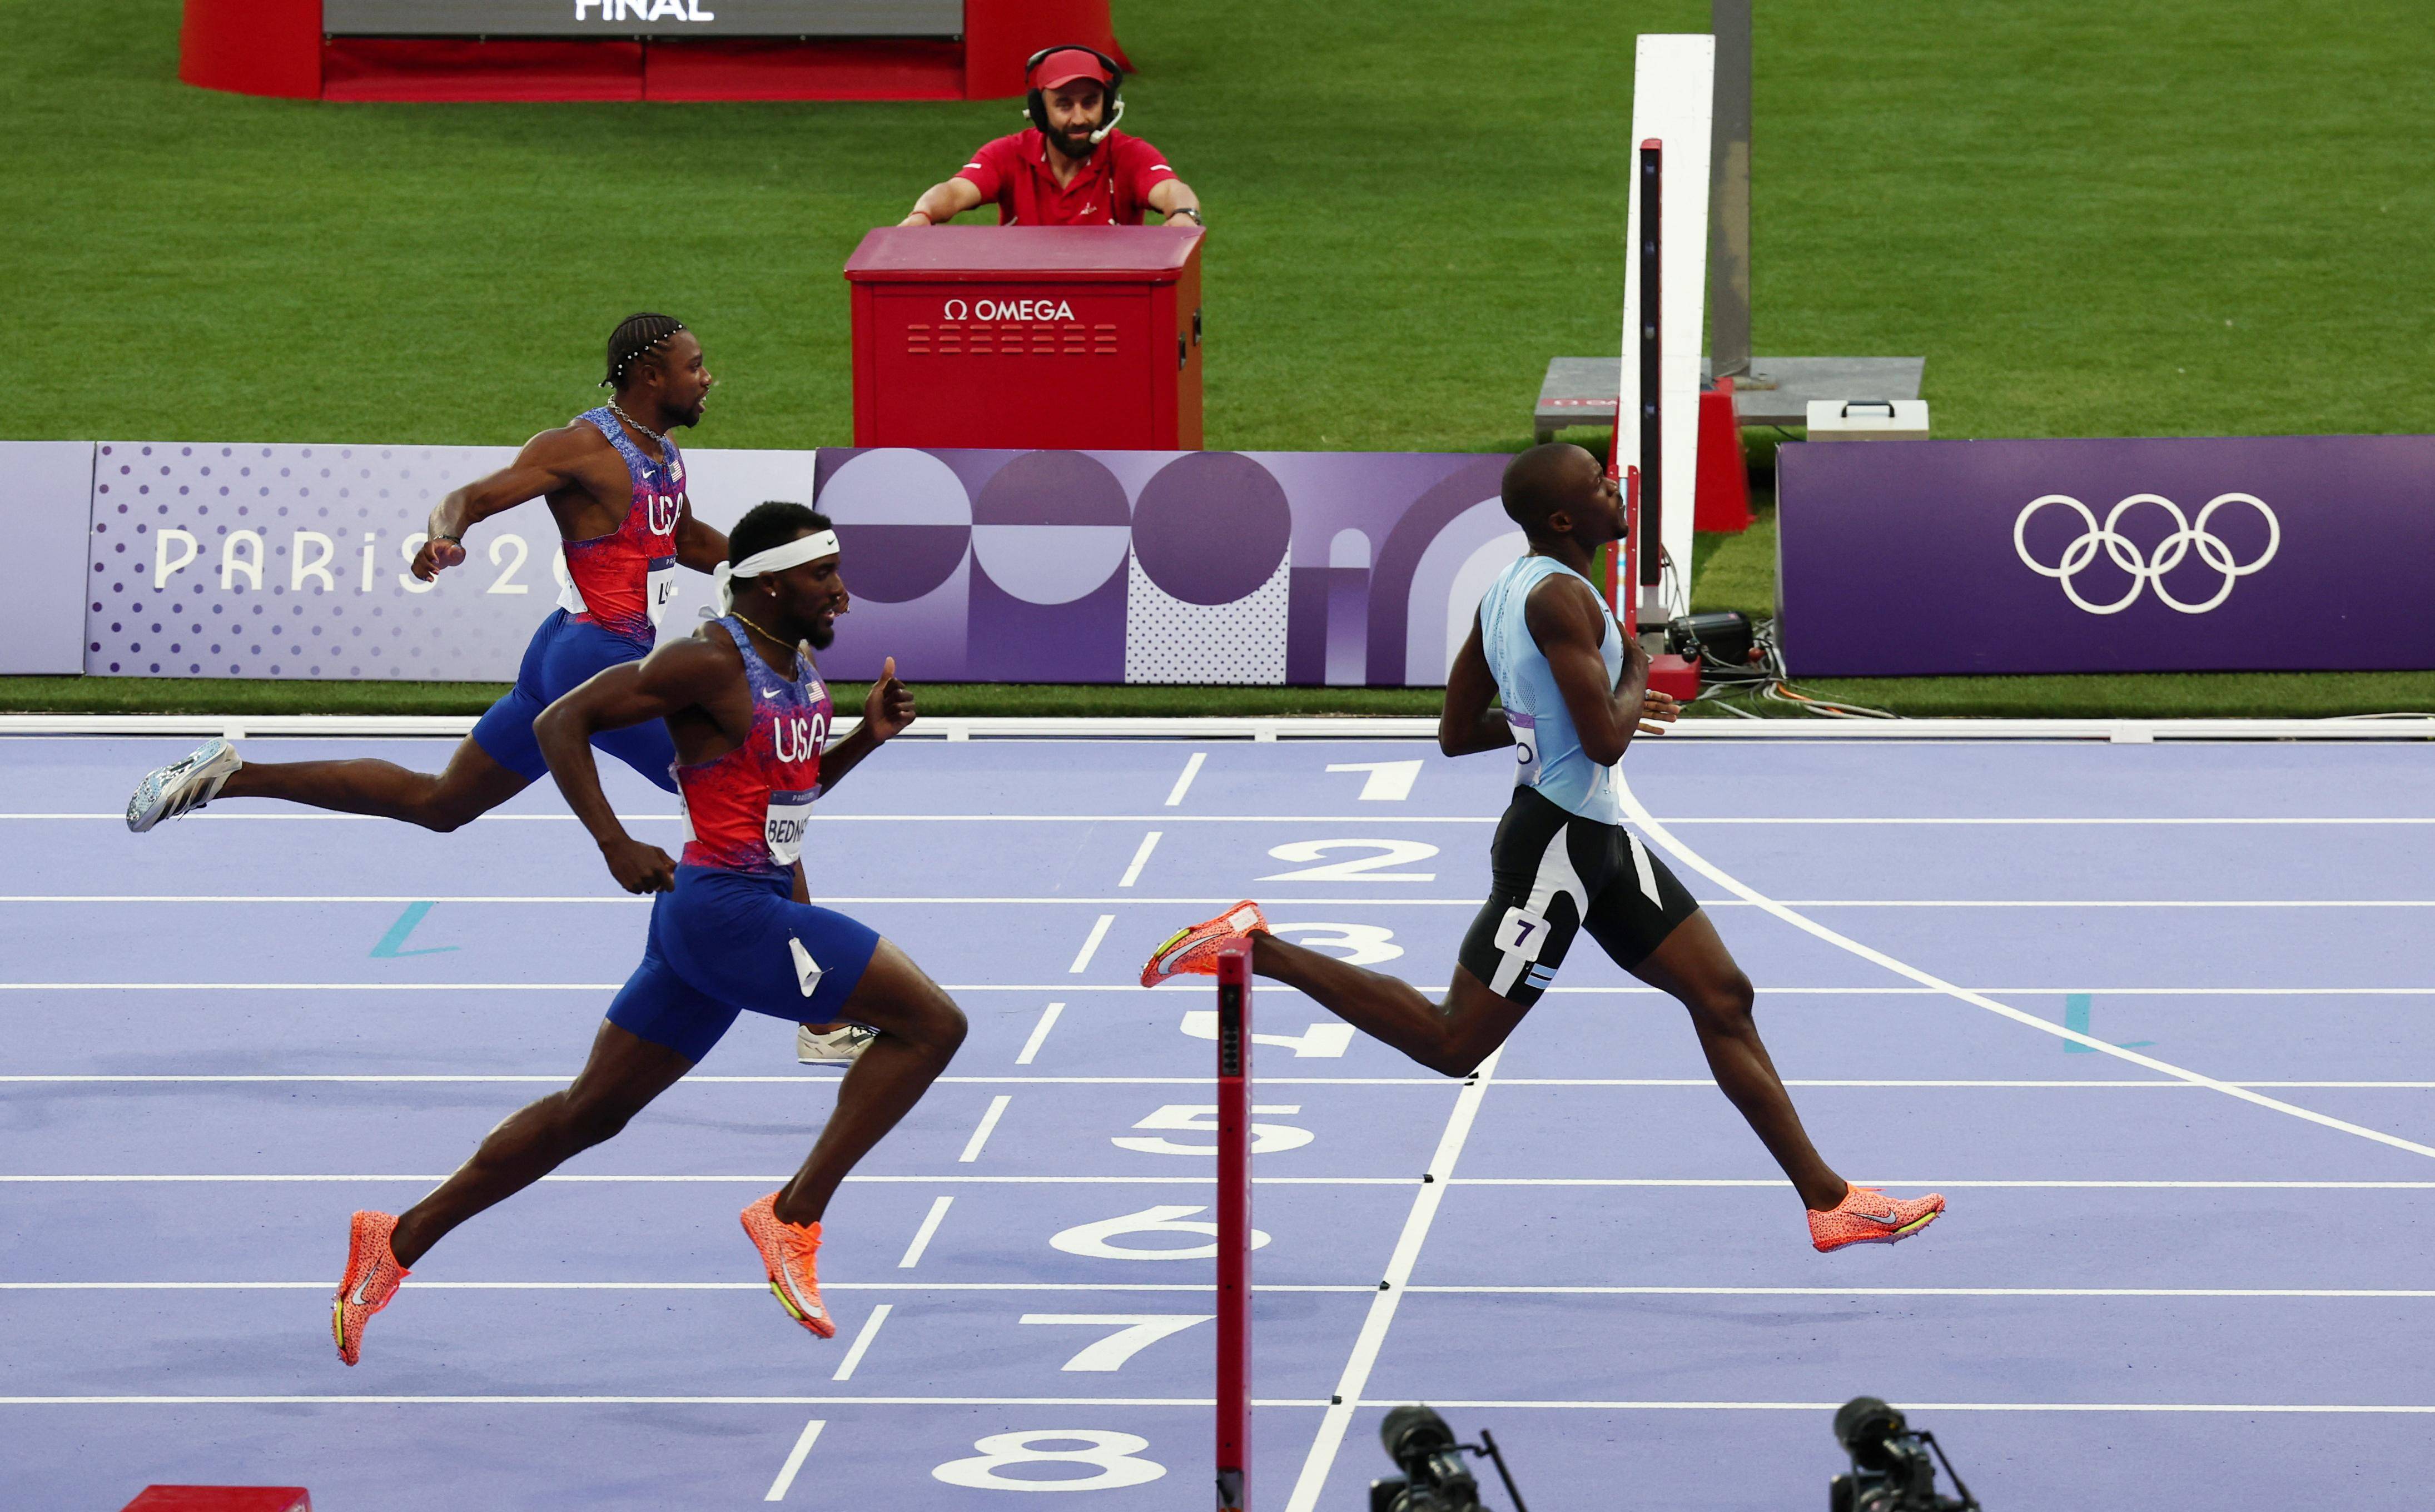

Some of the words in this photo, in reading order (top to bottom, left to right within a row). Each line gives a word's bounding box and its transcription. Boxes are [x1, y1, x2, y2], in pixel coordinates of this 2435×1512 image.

[975, 300, 1075, 321] OMEGA
[774, 713, 826, 763] USA
[1325, 759, 1424, 801] 1
[1253, 838, 1440, 882] 2
[1513, 919, 1536, 948] 7
[1111, 1104, 1315, 1156] 5
[1048, 1205, 1272, 1261] 6
[1018, 1314, 1218, 1372] 7
[931, 1429, 1167, 1492] 8
